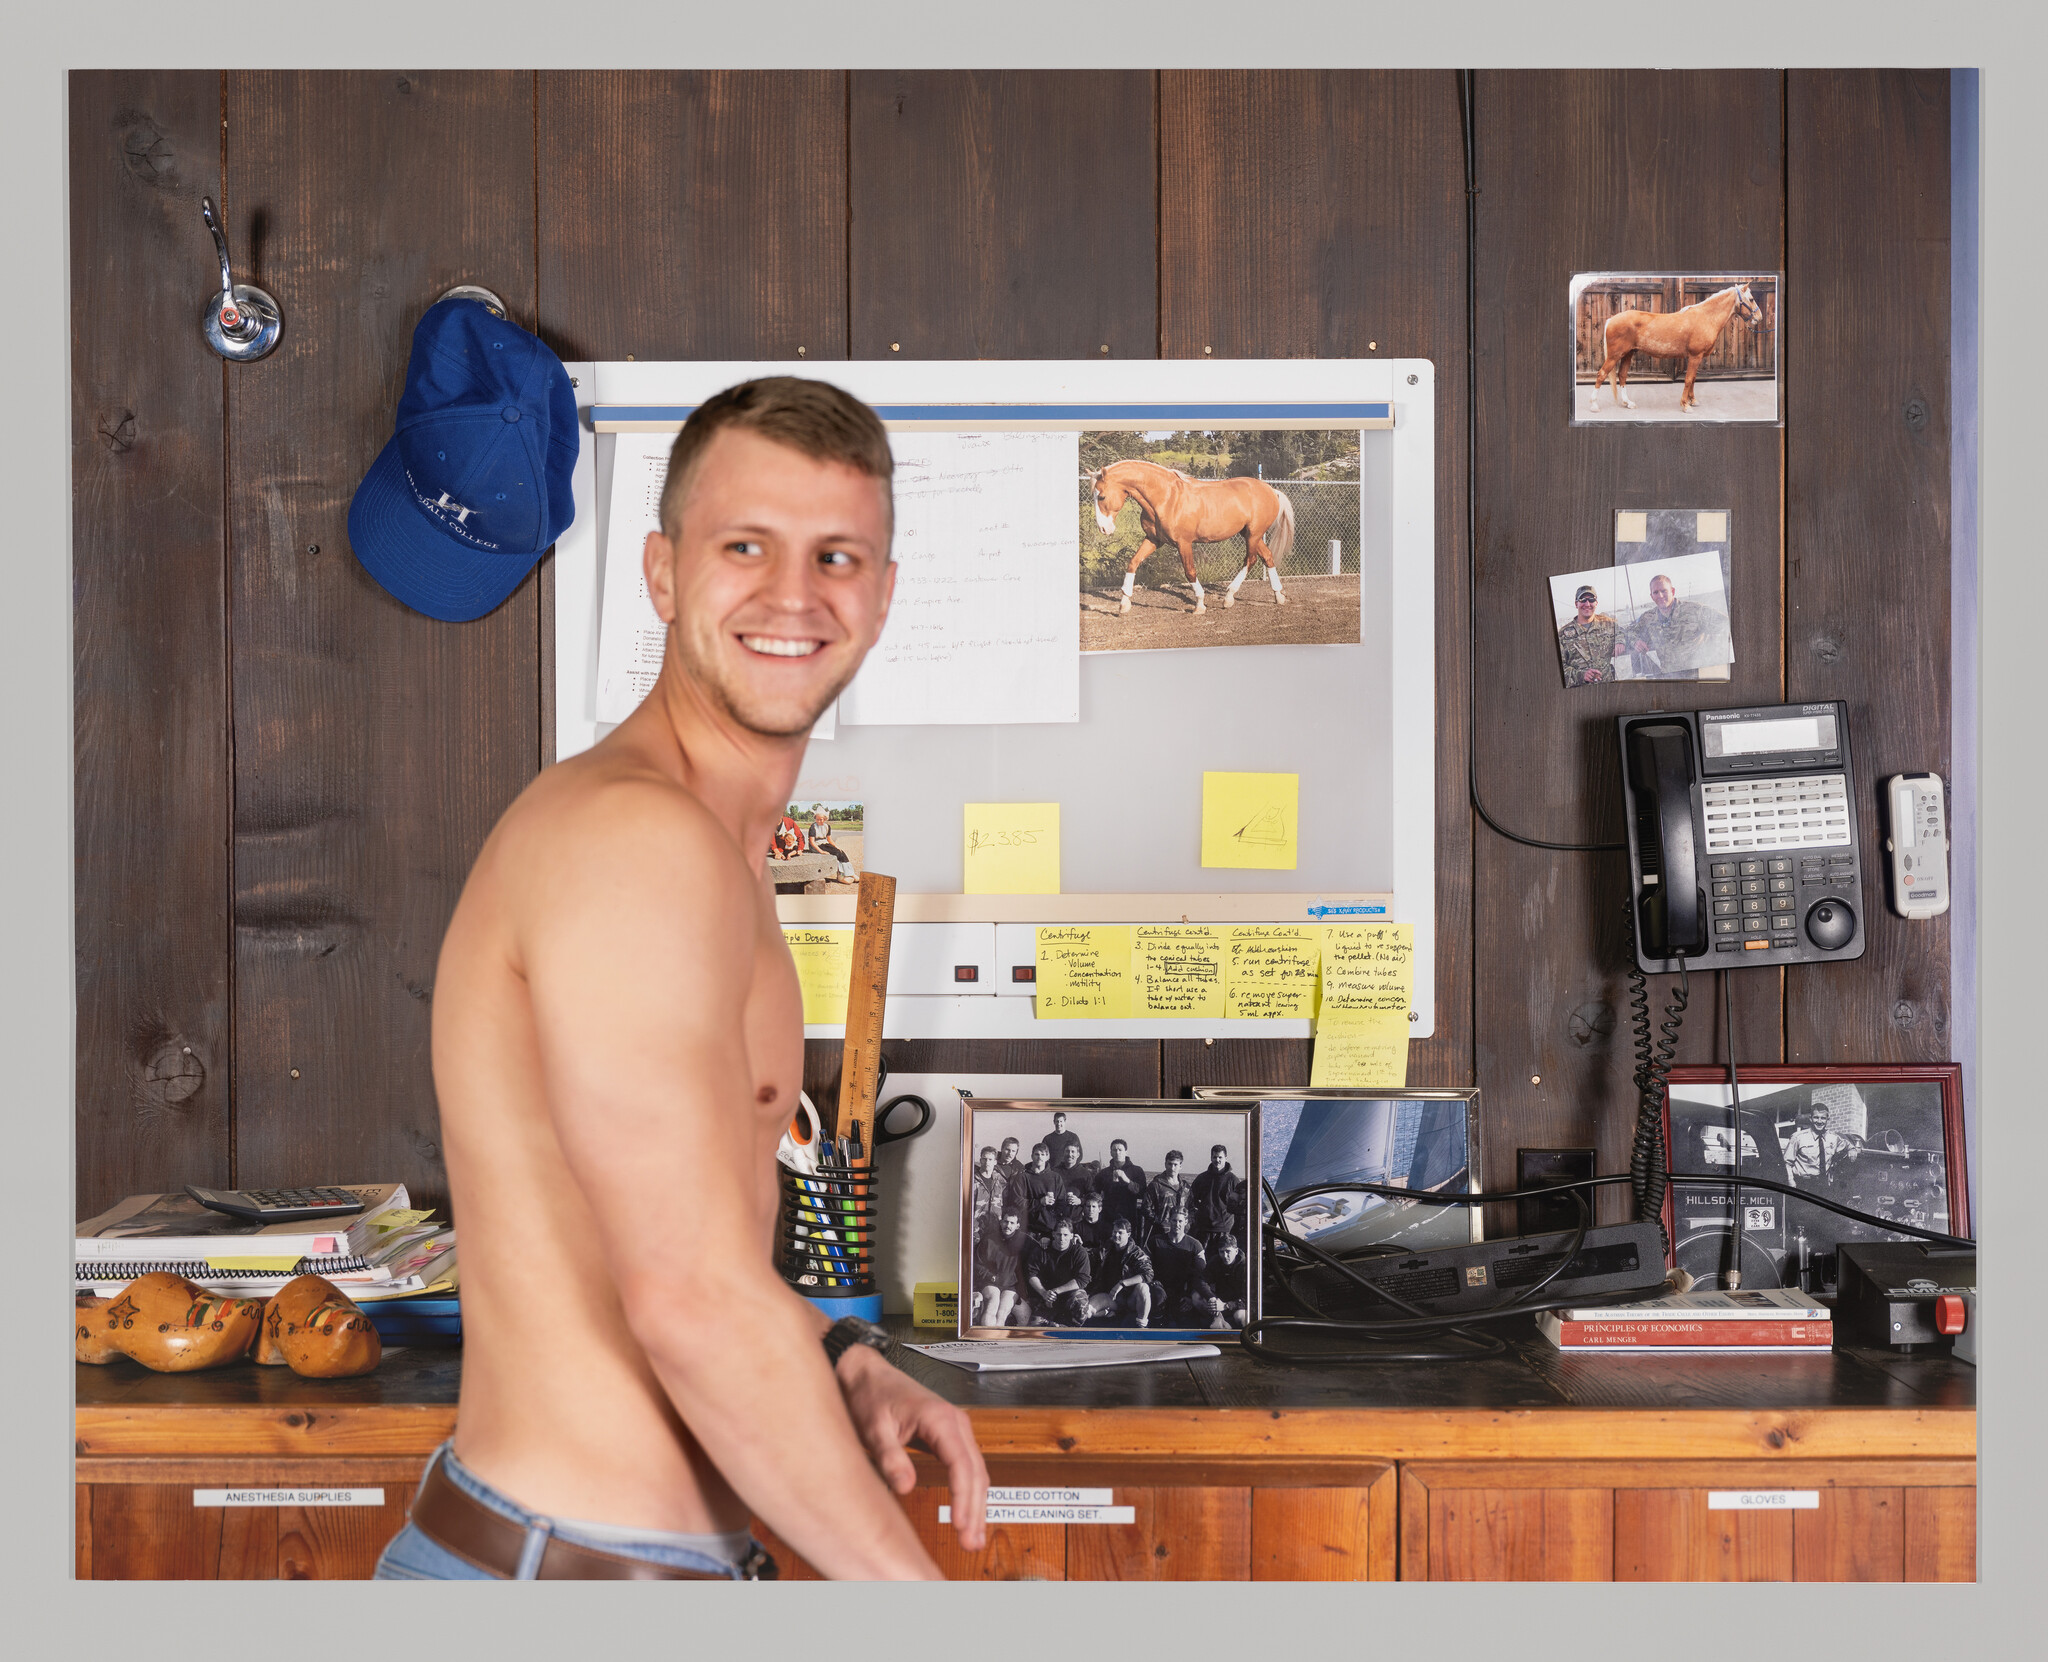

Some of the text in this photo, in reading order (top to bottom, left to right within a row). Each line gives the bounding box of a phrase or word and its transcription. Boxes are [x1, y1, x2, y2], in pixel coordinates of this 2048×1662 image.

[449, 521, 500, 549] COLLEGE
[1705, 712, 1741, 721] Panasonic
[1802, 703, 1835, 712] DIGITAL
[1720, 866, 1726, 875] 1
[1748, 864, 1756, 873] 2
[1777, 862, 1784, 871] 3
[1720, 885, 1728, 893] 4
[1750, 882, 1757, 891] 5
[1778, 881, 1785, 889] 6
[1723, 903, 1730, 912] 7
[1751, 901, 1758, 910] 8
[1779, 899, 1786, 908] 9
[1752, 920, 1759, 929] 0
[1040, 927, 1091, 942] Centrifuge
[1136, 926, 1181, 937] Centrifuge
[1339, 930, 1354, 938] Use
[1391, 930, 1400, 940] of
[1147, 941, 1171, 951] Divide
[1175, 942, 1205, 954] equally
[1206, 942, 1220, 950] into
[1056, 949, 1099, 959] Determine
[1189, 954, 1210, 963] tubes
[1333, 953, 1345, 961] the
[1068, 959, 1095, 968] Volume
[1243, 958, 1260, 966] run
[1069, 968, 1122, 978] Concentration
[1241, 969, 1254, 977] as
[1259, 967, 1276, 977] set
[1336, 966, 1370, 976] Combine
[1373, 966, 1398, 977] tubes
[1146, 974, 1179, 984] Balance
[1181, 974, 1193, 983] all
[1165, 985, 1183, 993] short
[1147, 1002, 1177, 1010] balance
[1686, 1195, 1749, 1206] HILLSDAE,
[1583, 1323, 1703, 1333] PRINCIPLES OF ECONOMICS
[226, 1491, 352, 1502] ANESTHESIA SUPPLIES
[1033, 1490, 1080, 1501] COTTON
[1741, 1494, 1786, 1505] GLOVES
[1018, 1509, 1075, 1519] CLEANING
[1078, 1509, 1102, 1519] SET.
